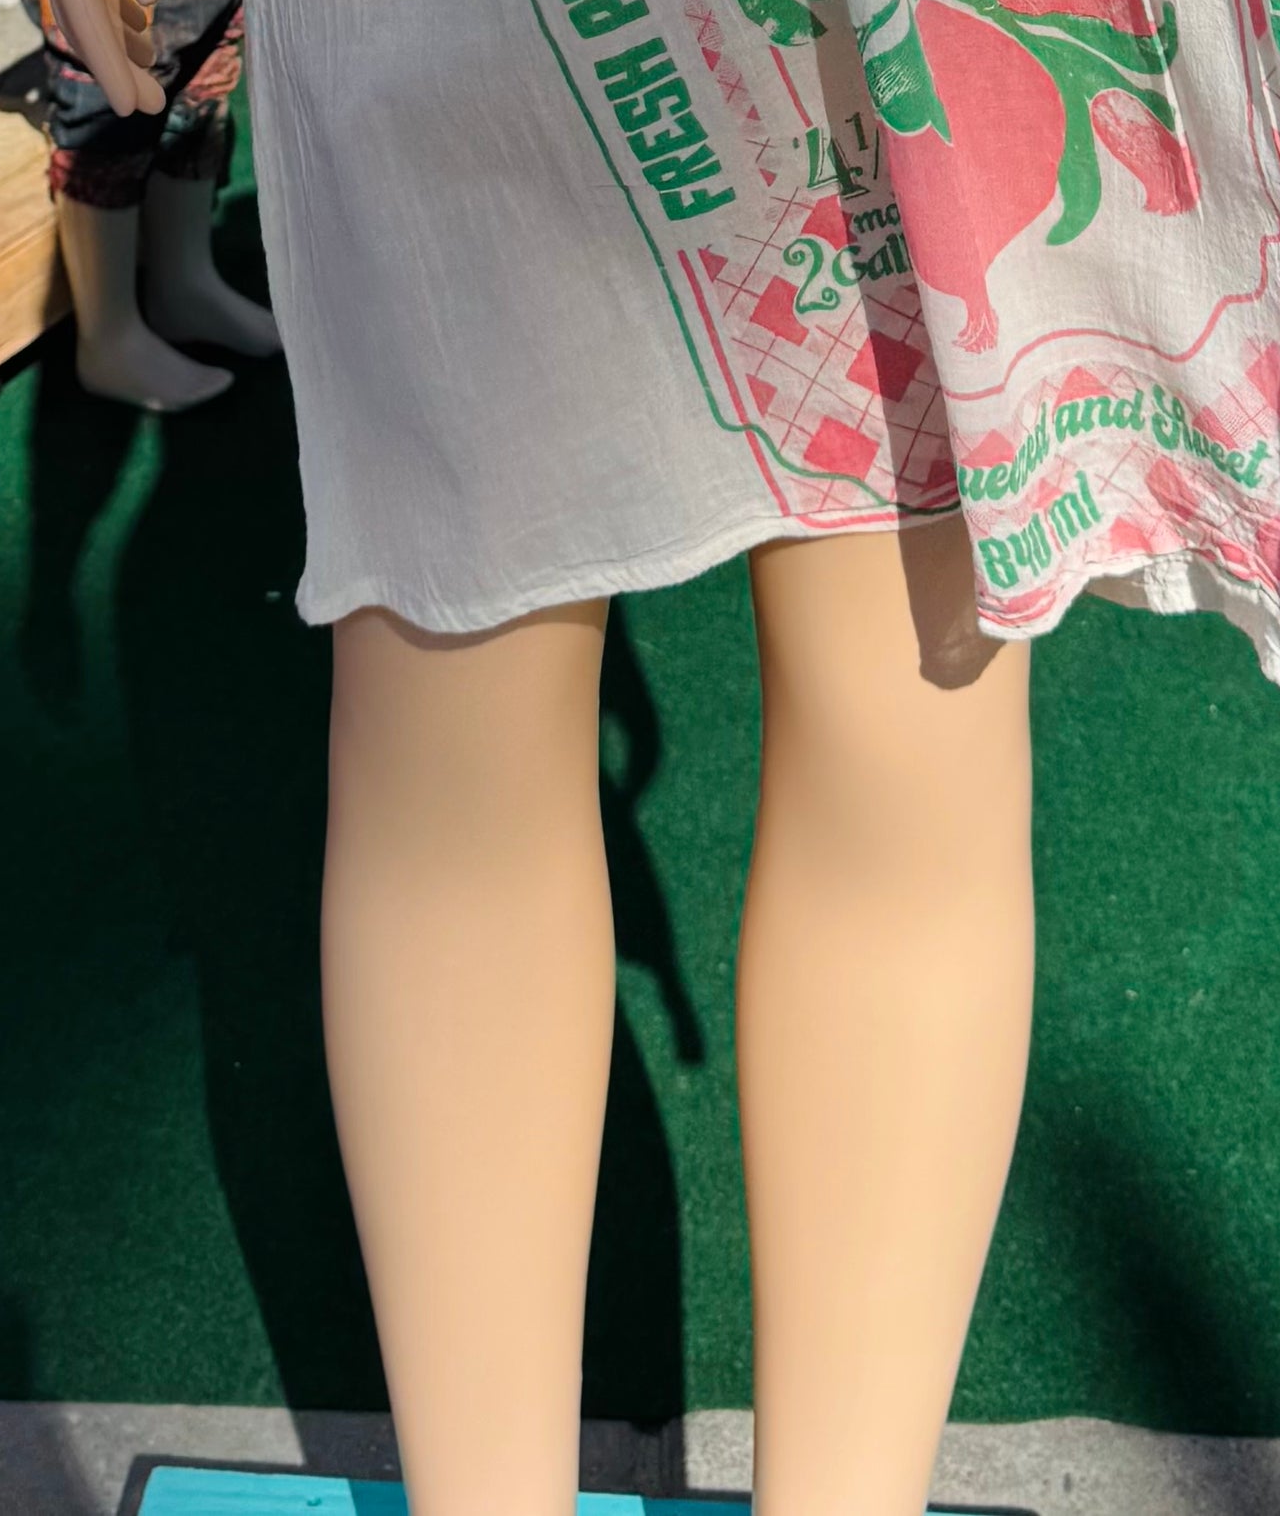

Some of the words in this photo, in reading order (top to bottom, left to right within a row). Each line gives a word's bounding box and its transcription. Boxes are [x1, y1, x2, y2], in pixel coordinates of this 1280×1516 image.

[593, 36, 735, 222] FRESH
[782, 237, 840, 315] 2
[1054, 387, 1146, 444] and
